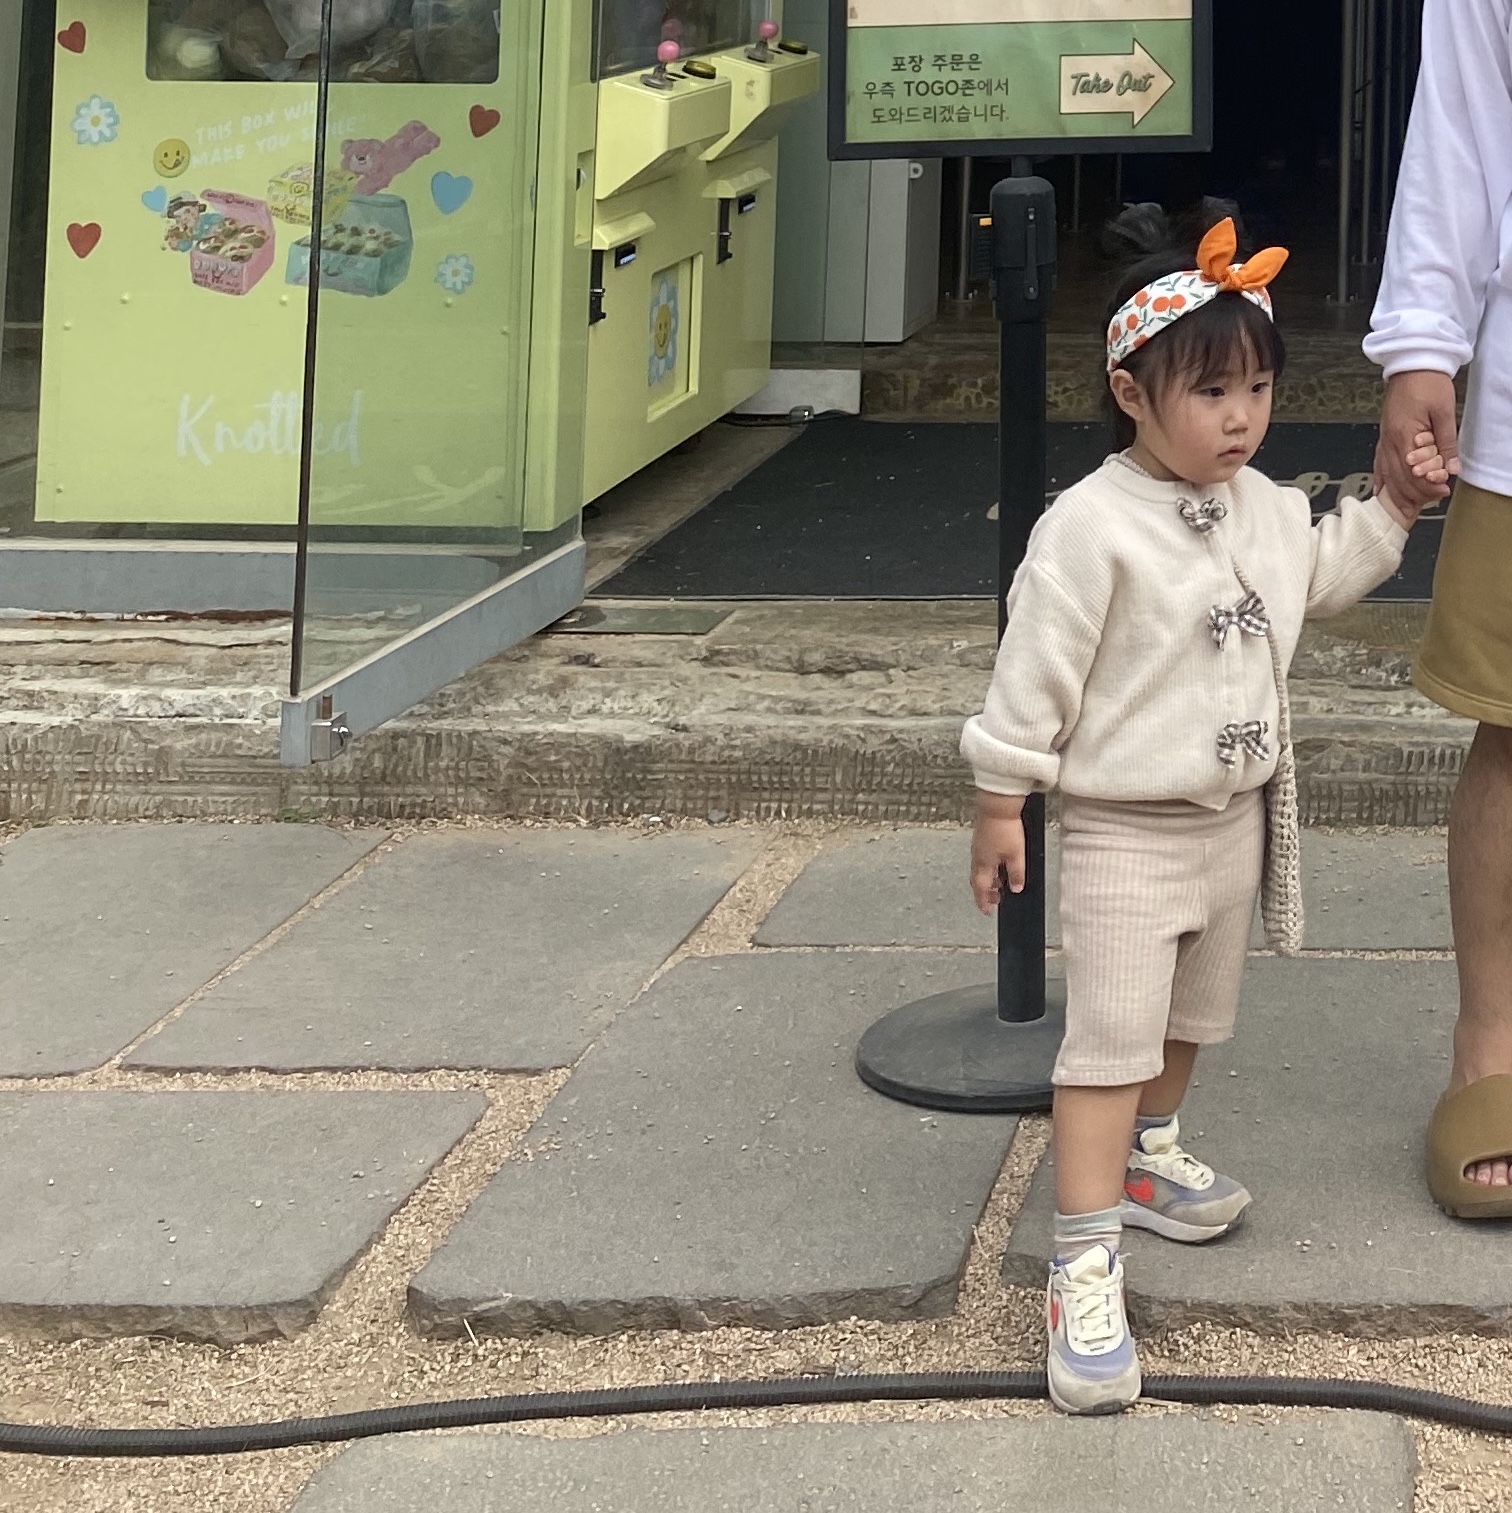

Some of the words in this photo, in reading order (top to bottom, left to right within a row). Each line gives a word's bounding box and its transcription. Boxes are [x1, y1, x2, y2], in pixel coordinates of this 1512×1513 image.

[891, 54, 923, 73] 포장
[931, 53, 983, 72] 주문은
[864, 81, 895, 100] 우측
[904, 78, 1010, 97] TOGO존에서
[1070, 72, 1113, 96] Take
[1115, 71, 1155, 96] Out
